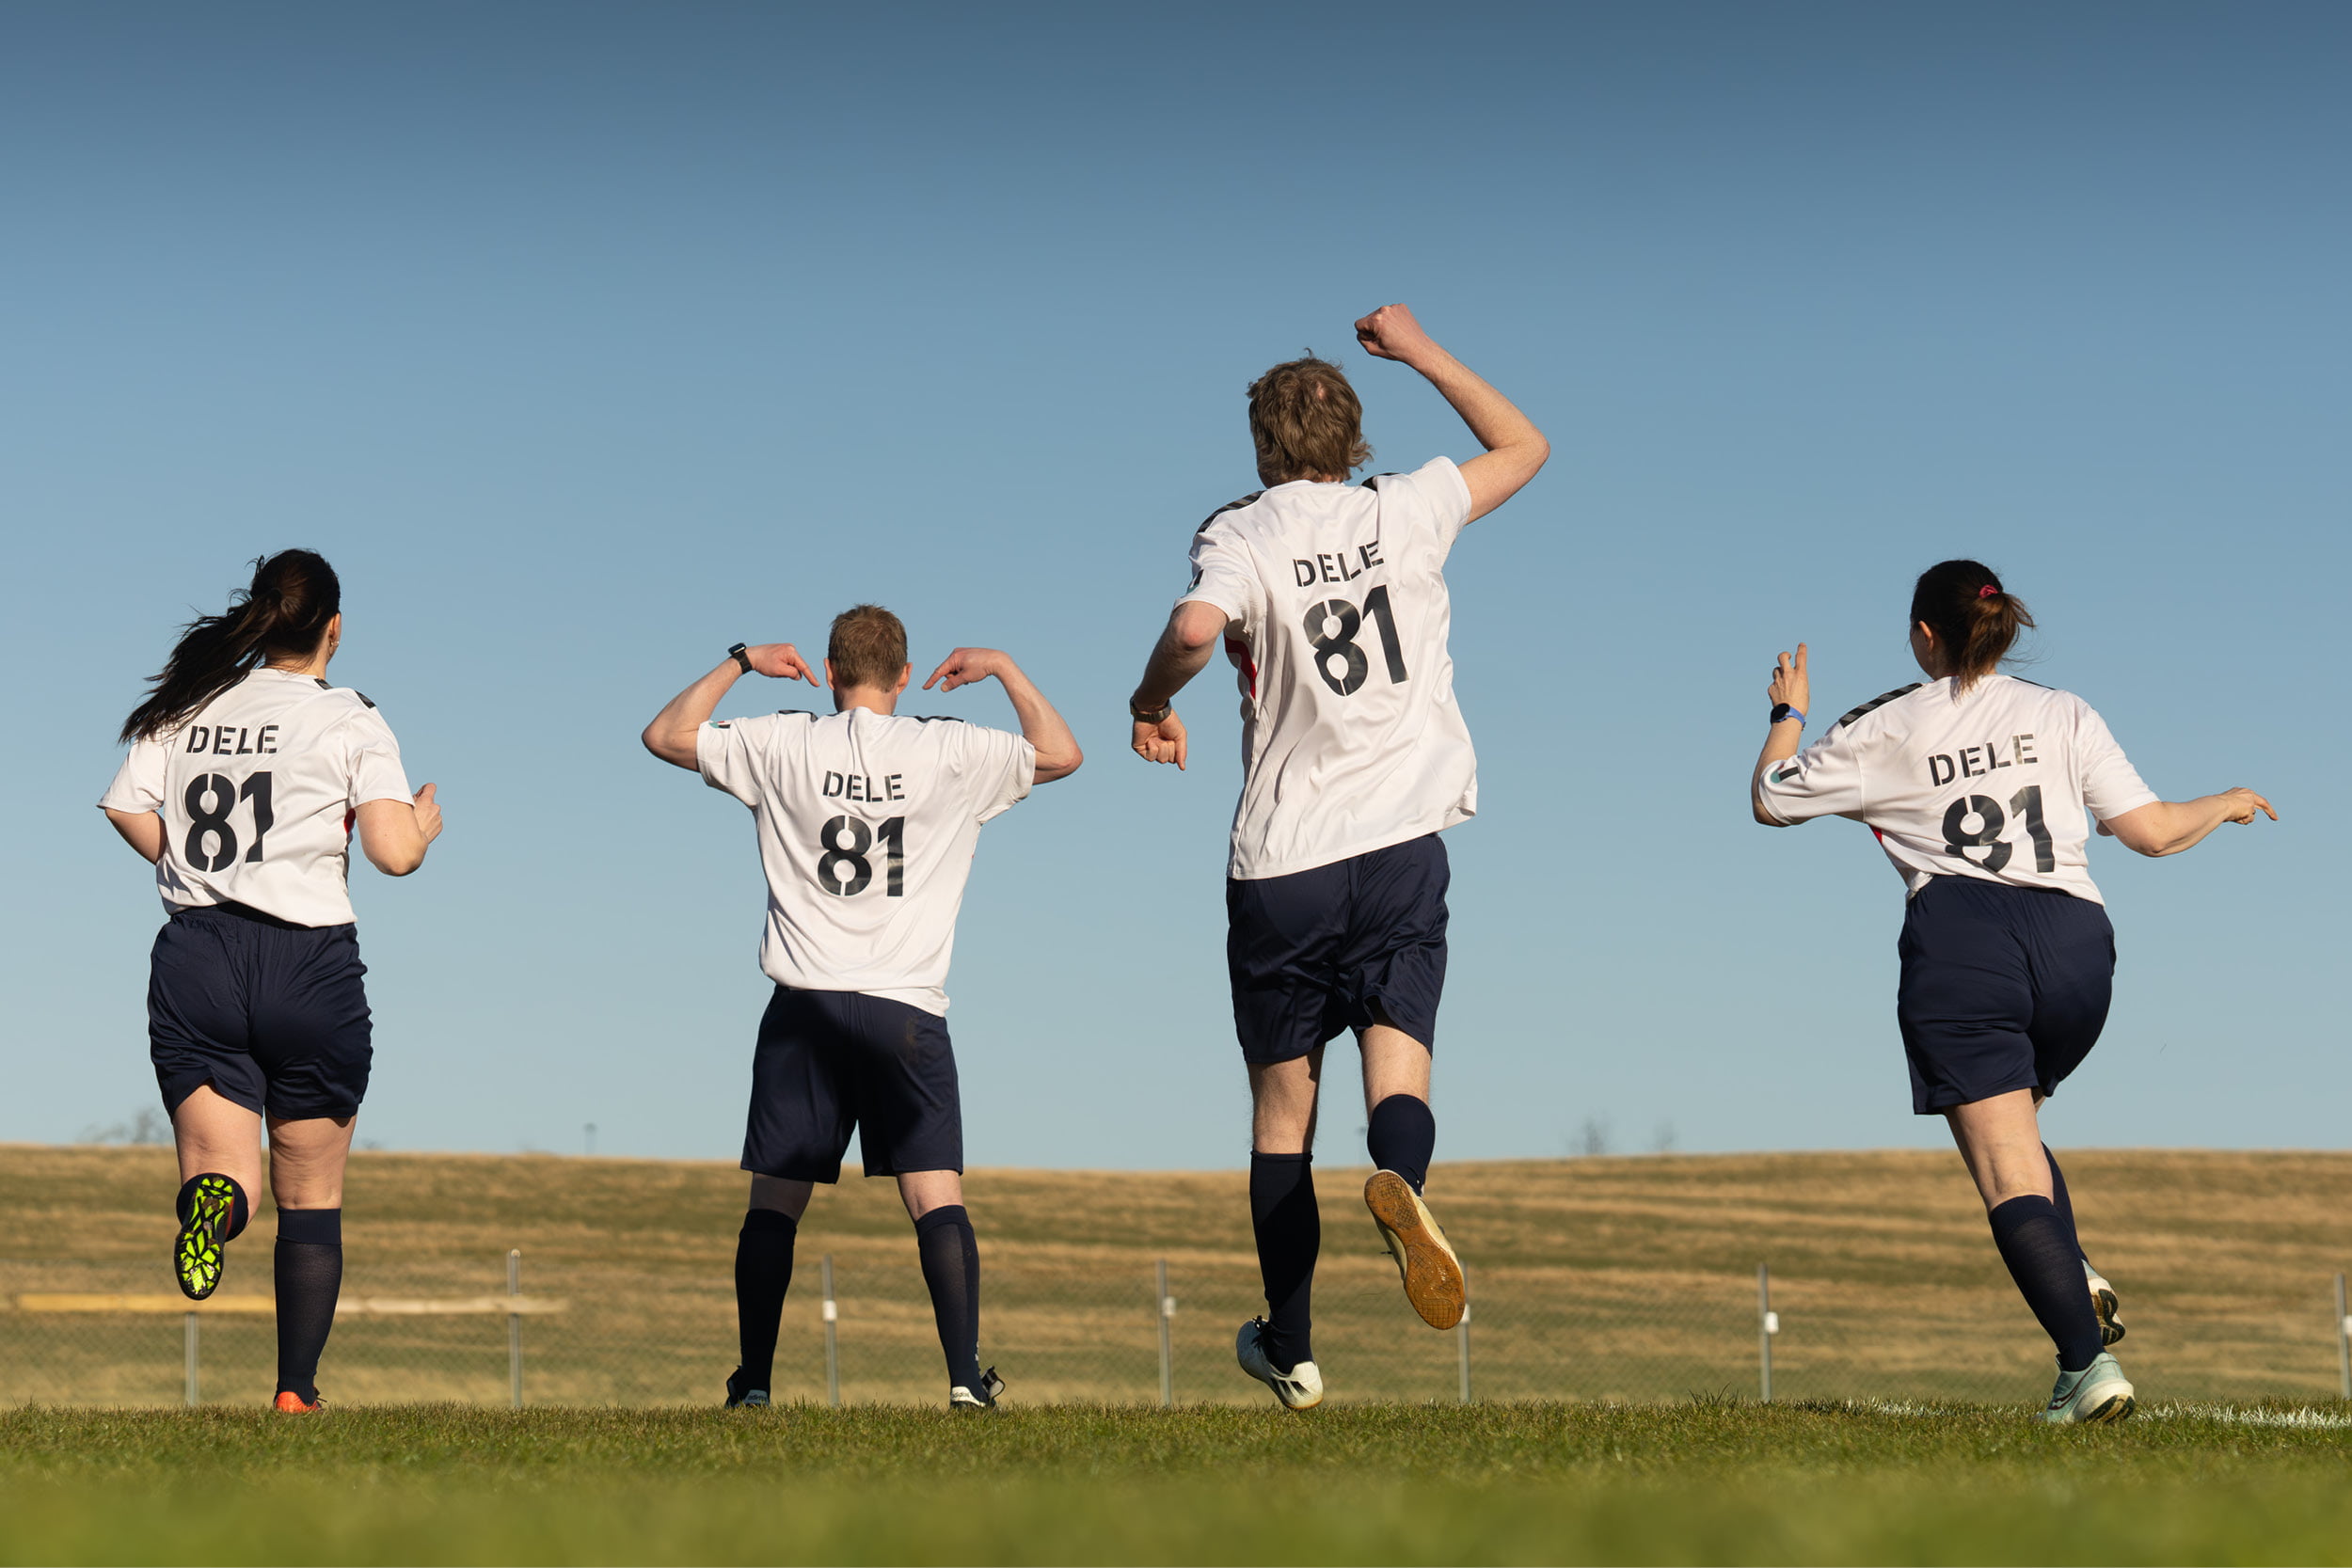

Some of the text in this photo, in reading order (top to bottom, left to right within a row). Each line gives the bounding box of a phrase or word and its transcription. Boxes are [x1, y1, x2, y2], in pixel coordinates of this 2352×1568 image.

[1294, 539, 1384, 588] DELE
[1303, 584, 1410, 697] 81
[185, 724, 279, 755] DELE
[1928, 734, 2039, 787] DELE
[822, 770, 905, 802] DELE
[184, 771, 275, 873] 81
[1941, 784, 2056, 874] 81
[818, 815, 905, 897] 81
